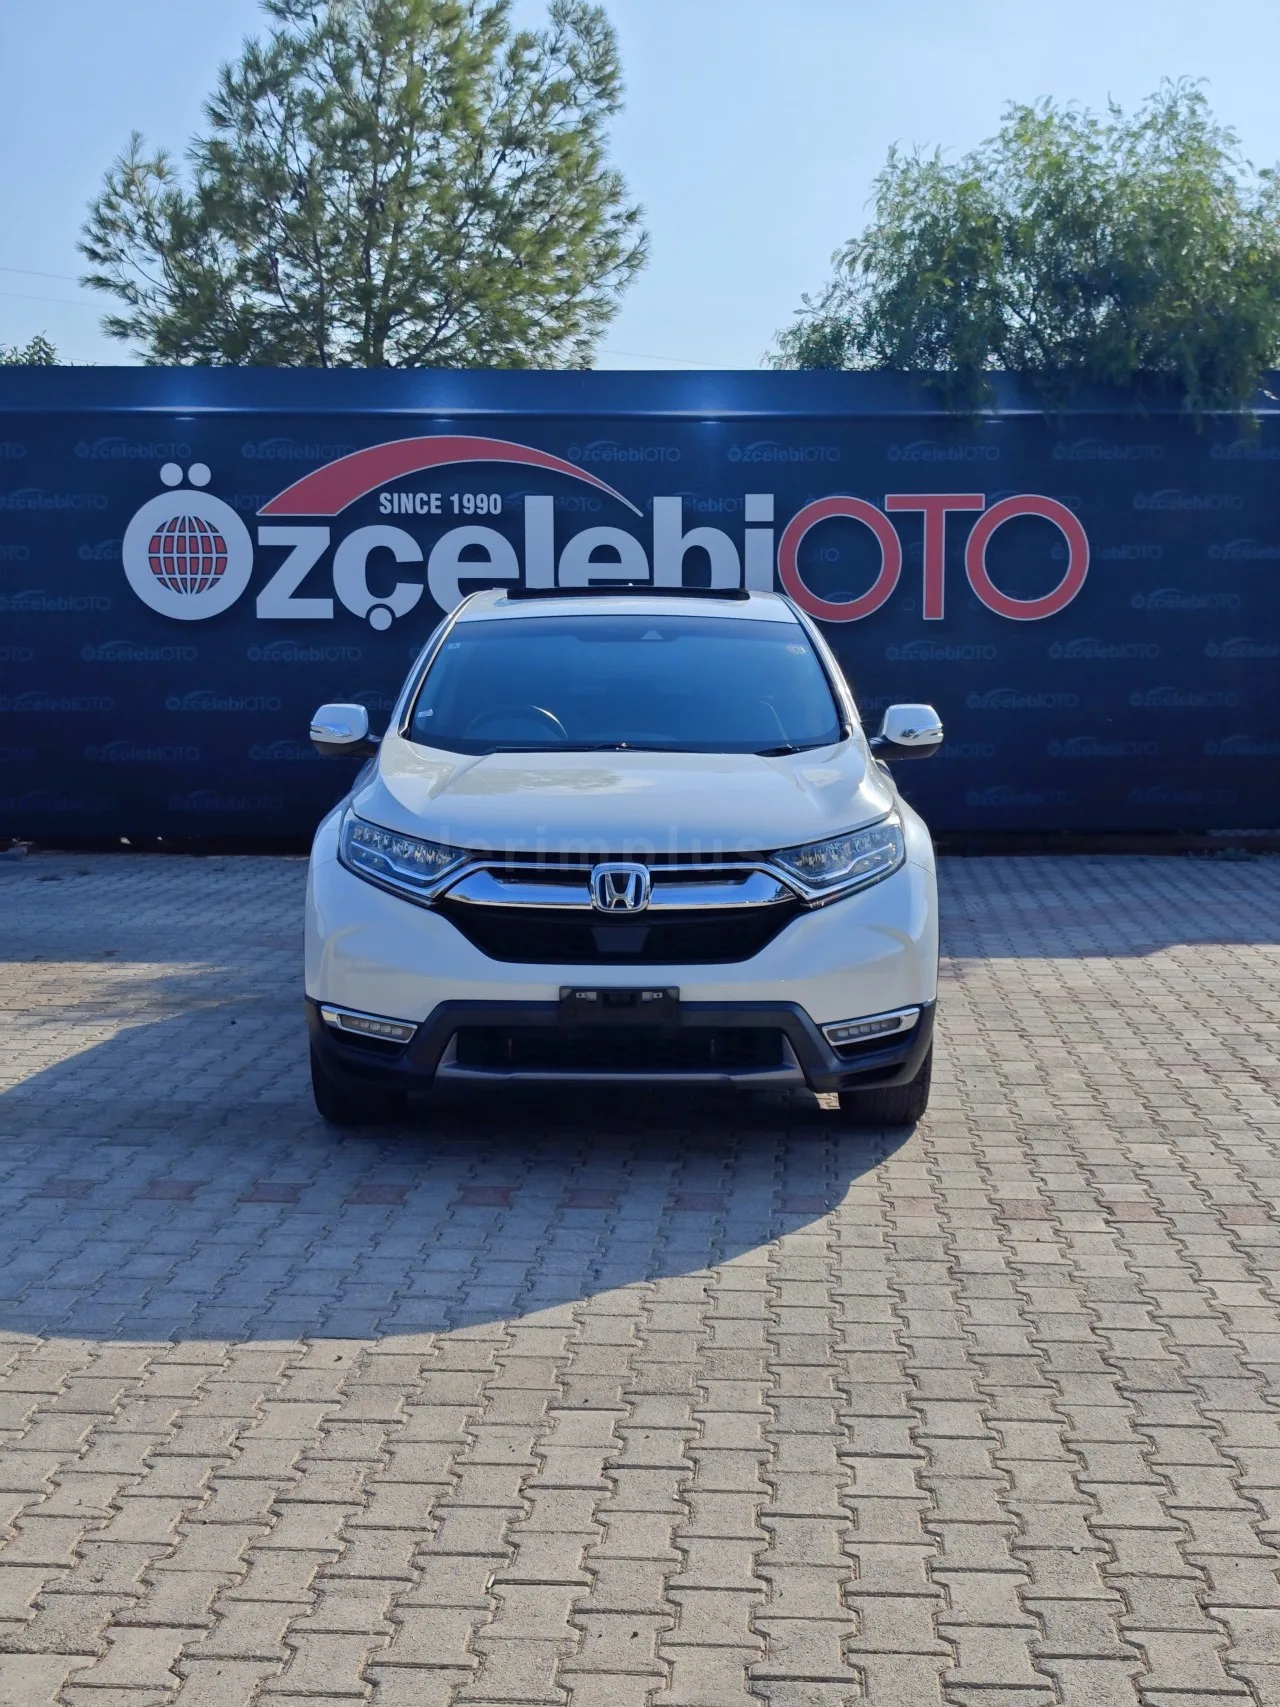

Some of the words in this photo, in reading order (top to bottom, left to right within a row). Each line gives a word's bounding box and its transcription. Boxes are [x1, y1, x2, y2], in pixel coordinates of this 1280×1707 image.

[122, 462, 1090, 632] ÖzçelebiOTO
[379, 492, 442, 515] SINCE
[449, 492, 502, 515] 1990
